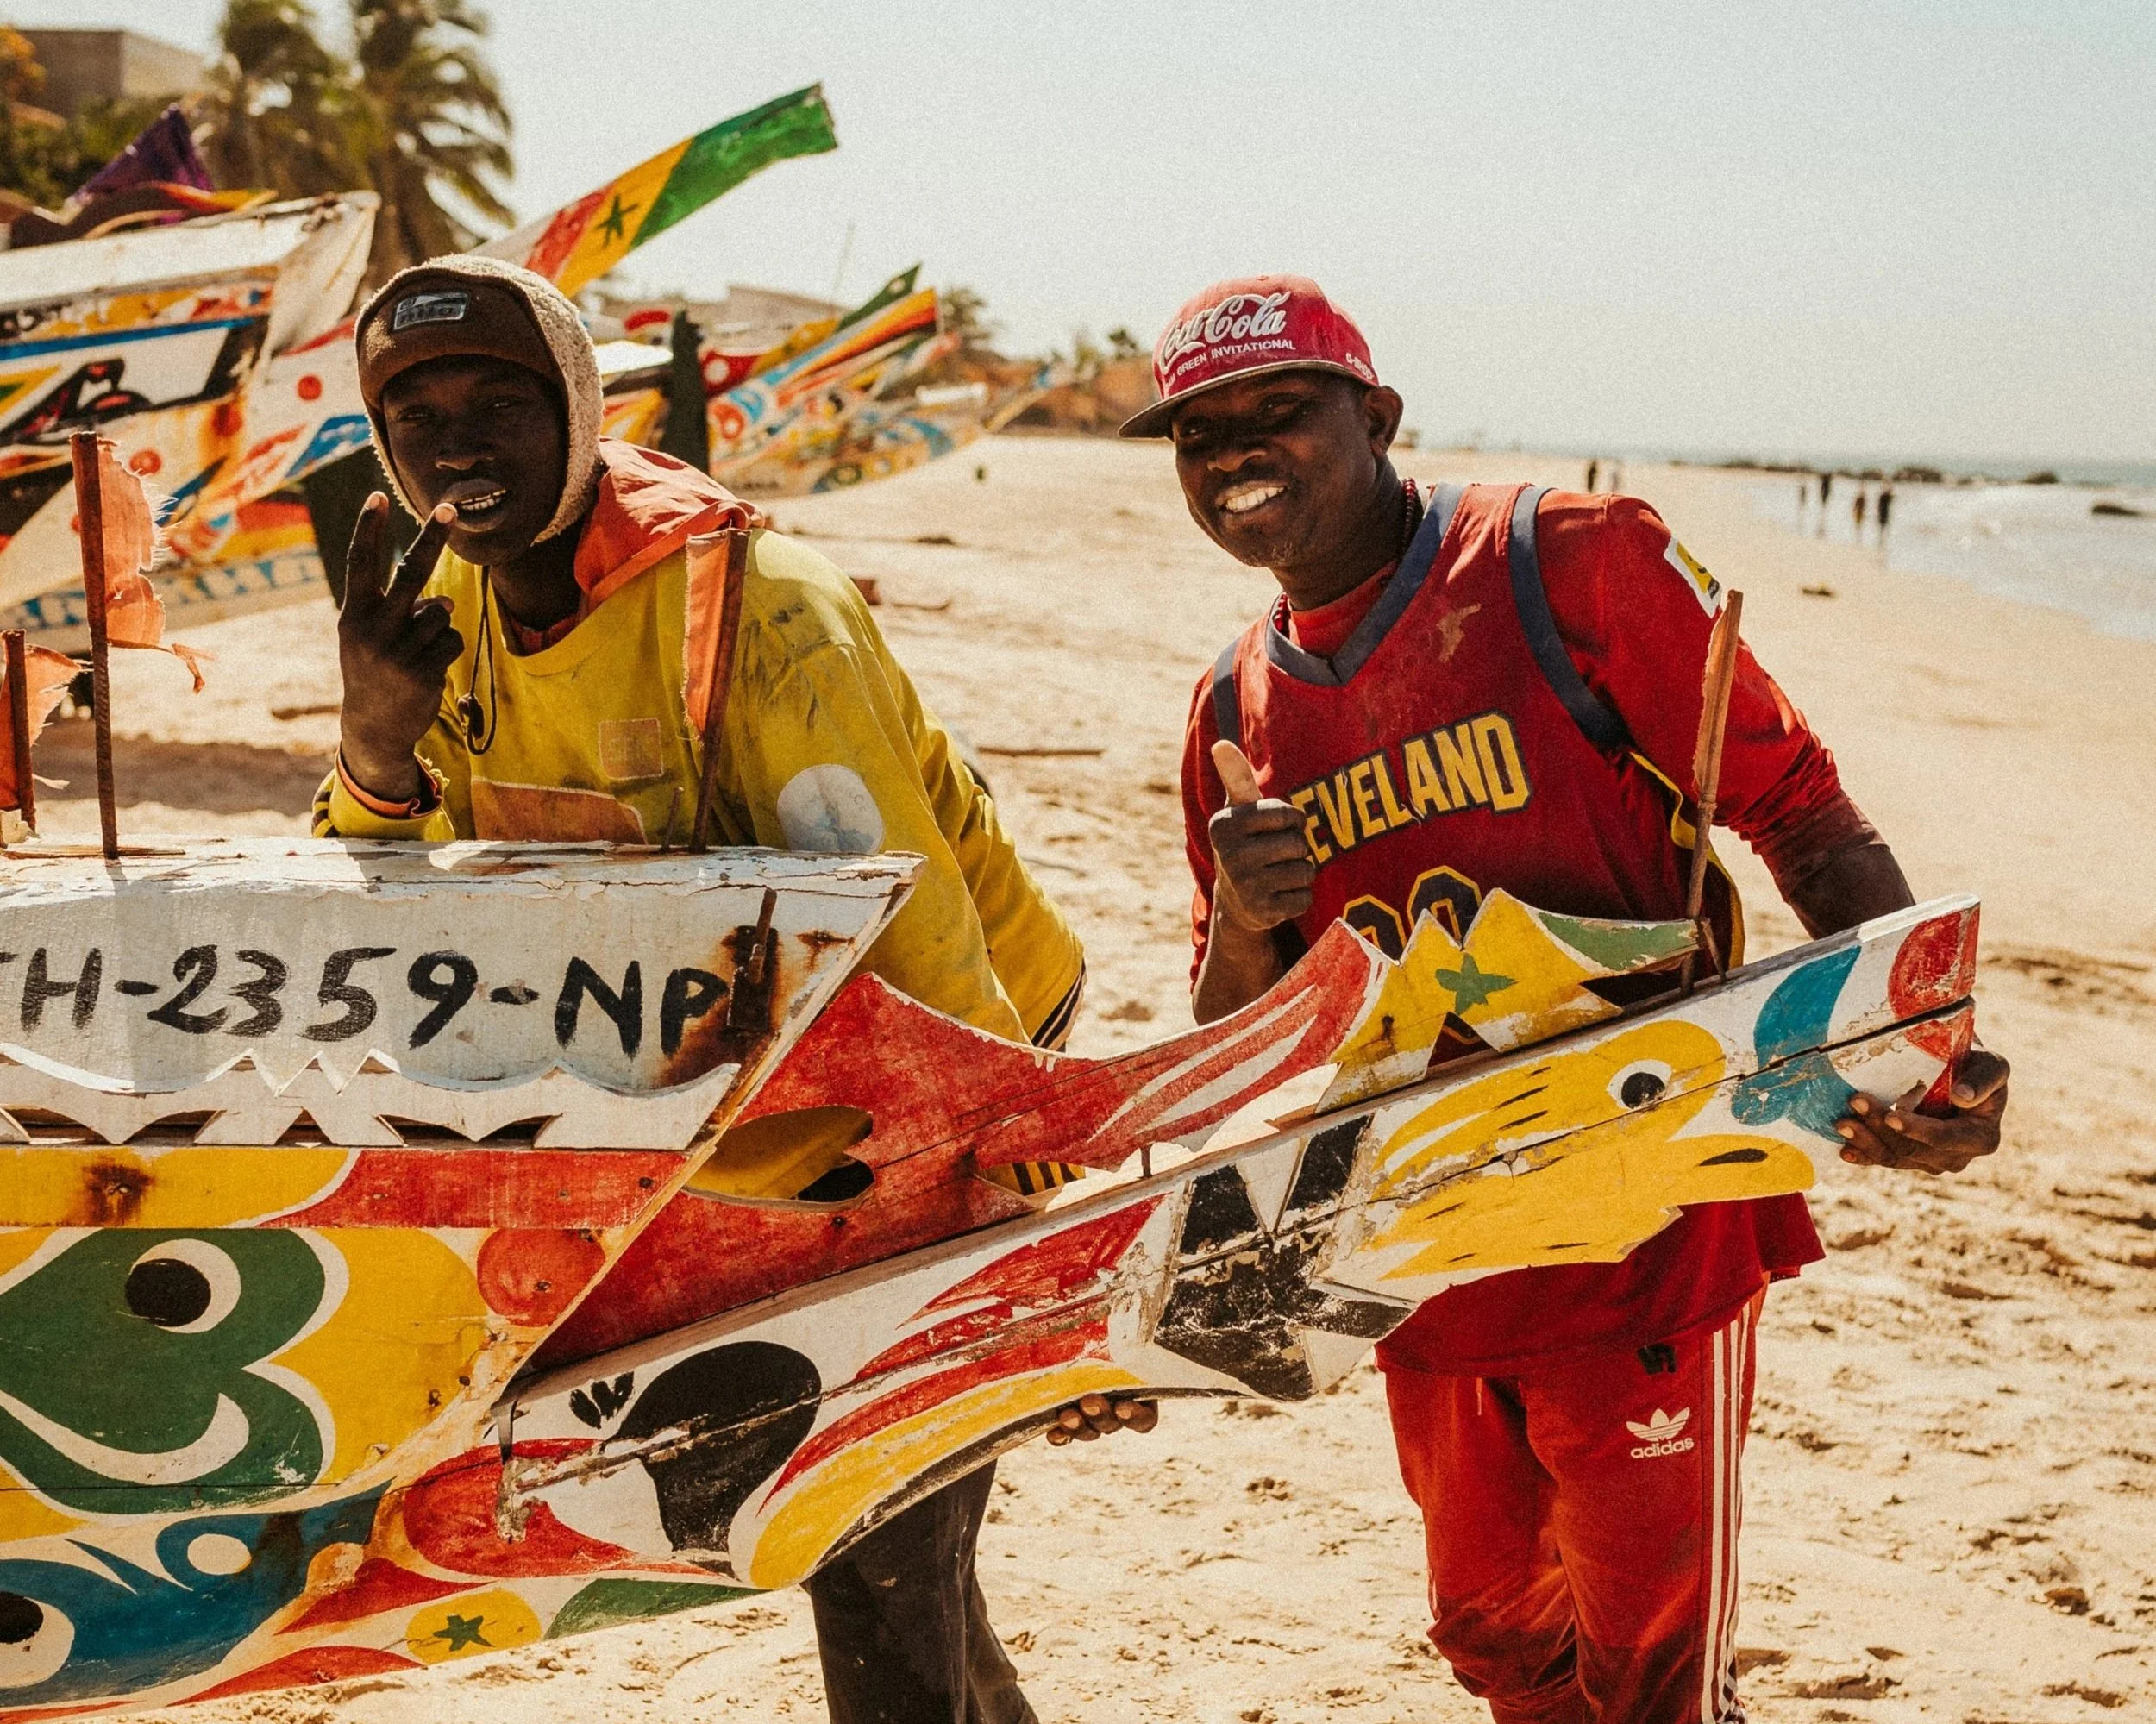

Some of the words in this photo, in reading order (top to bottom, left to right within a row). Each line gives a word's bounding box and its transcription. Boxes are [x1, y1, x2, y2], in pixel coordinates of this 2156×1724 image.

[1177, 352, 1208, 376] GREEN
[1211, 339, 1296, 359] INVITATIONAL
[1288, 711, 1532, 868] EVELAND
[0, 944, 730, 1063] H-2359-NP
[1630, 1437, 1695, 1459] adidas
